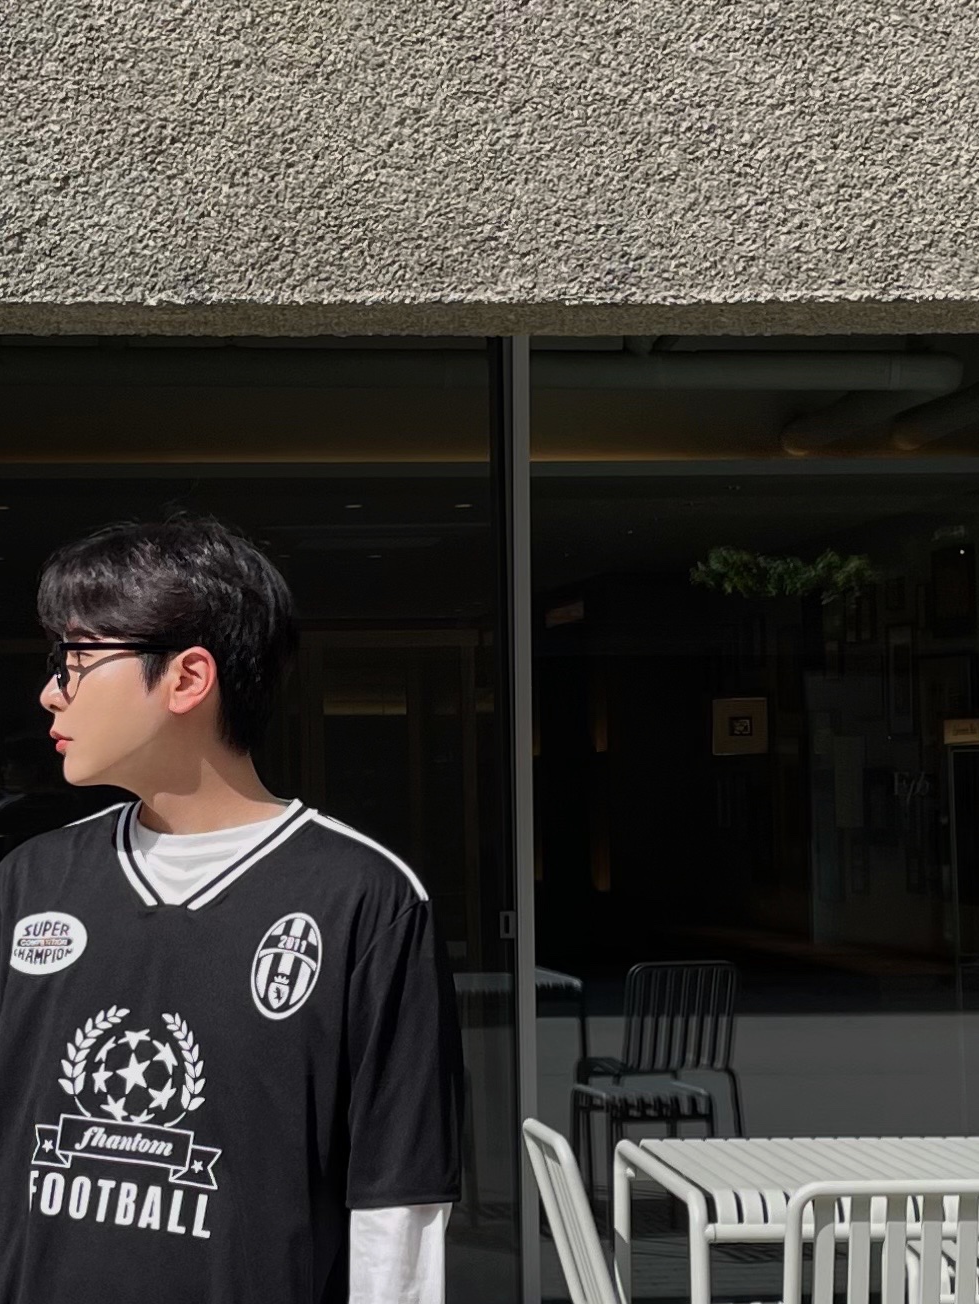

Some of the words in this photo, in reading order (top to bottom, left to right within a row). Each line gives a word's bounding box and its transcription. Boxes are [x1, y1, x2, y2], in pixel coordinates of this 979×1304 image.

[23, 920, 70, 936] SUPER
[277, 935, 307, 953] 2011
[29, 1170, 211, 1239] FOOTBALL
